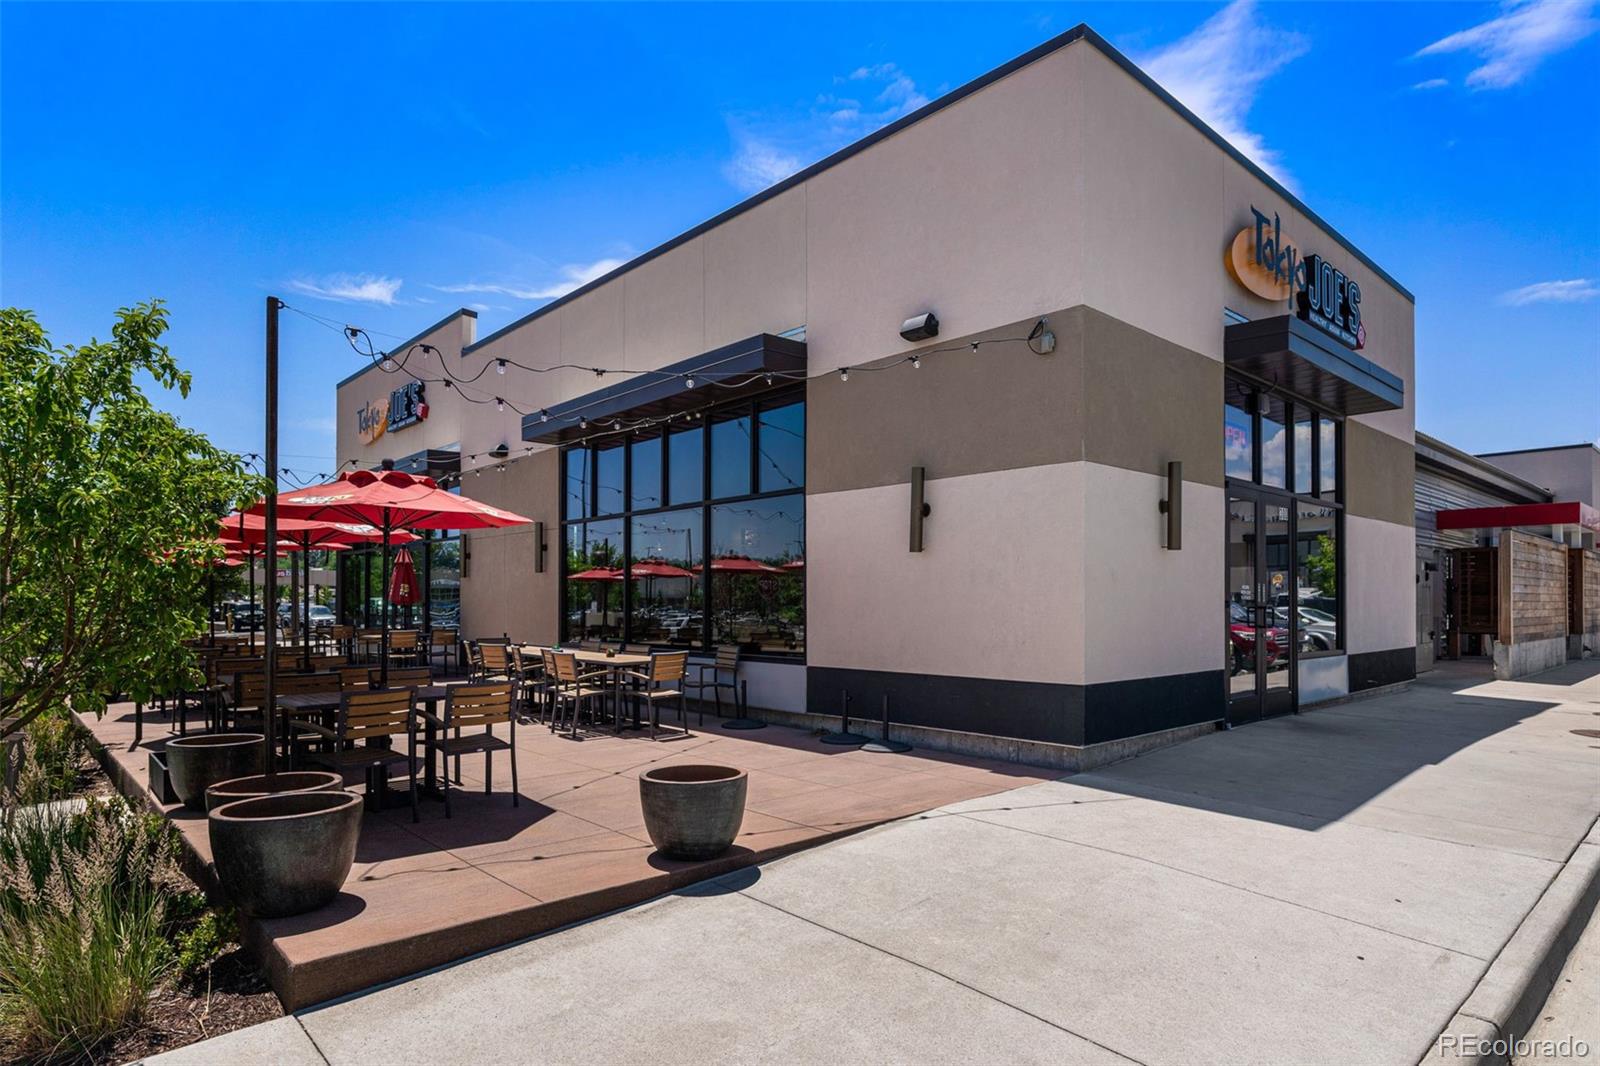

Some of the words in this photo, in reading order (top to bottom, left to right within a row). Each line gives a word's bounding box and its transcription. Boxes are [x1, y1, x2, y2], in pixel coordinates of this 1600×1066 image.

[1250, 204, 1307, 310] Tokyo
[1308, 254, 1361, 334] JOE'S
[357, 401, 380, 437] Tokyo
[388, 380, 420, 423] JOE'S
